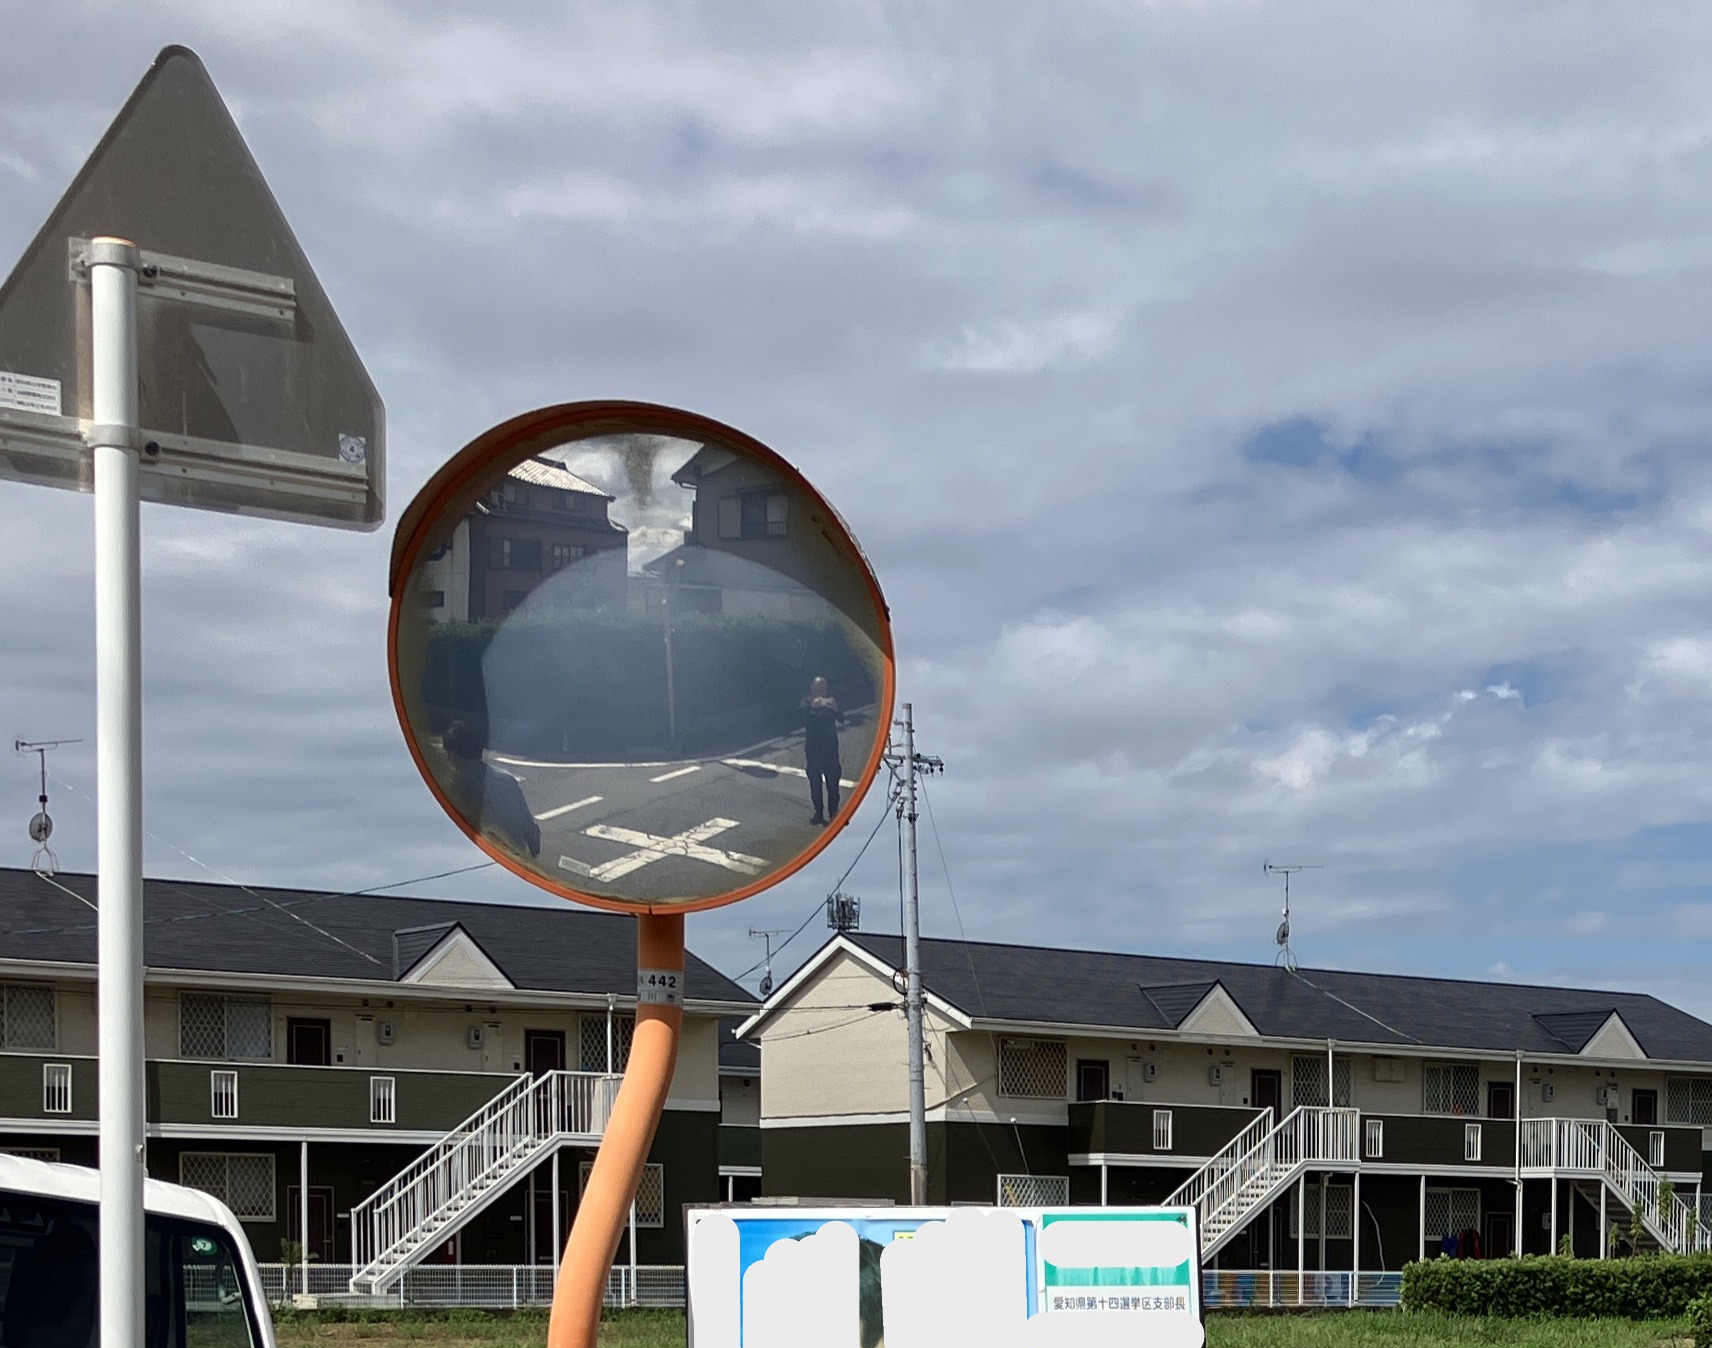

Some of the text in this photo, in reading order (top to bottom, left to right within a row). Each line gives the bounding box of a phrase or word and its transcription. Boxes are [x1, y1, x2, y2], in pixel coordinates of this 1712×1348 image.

[647, 974, 677, 989] 442
[1053, 1296, 1186, 1311] 愛知県第十四選挙区支部長
